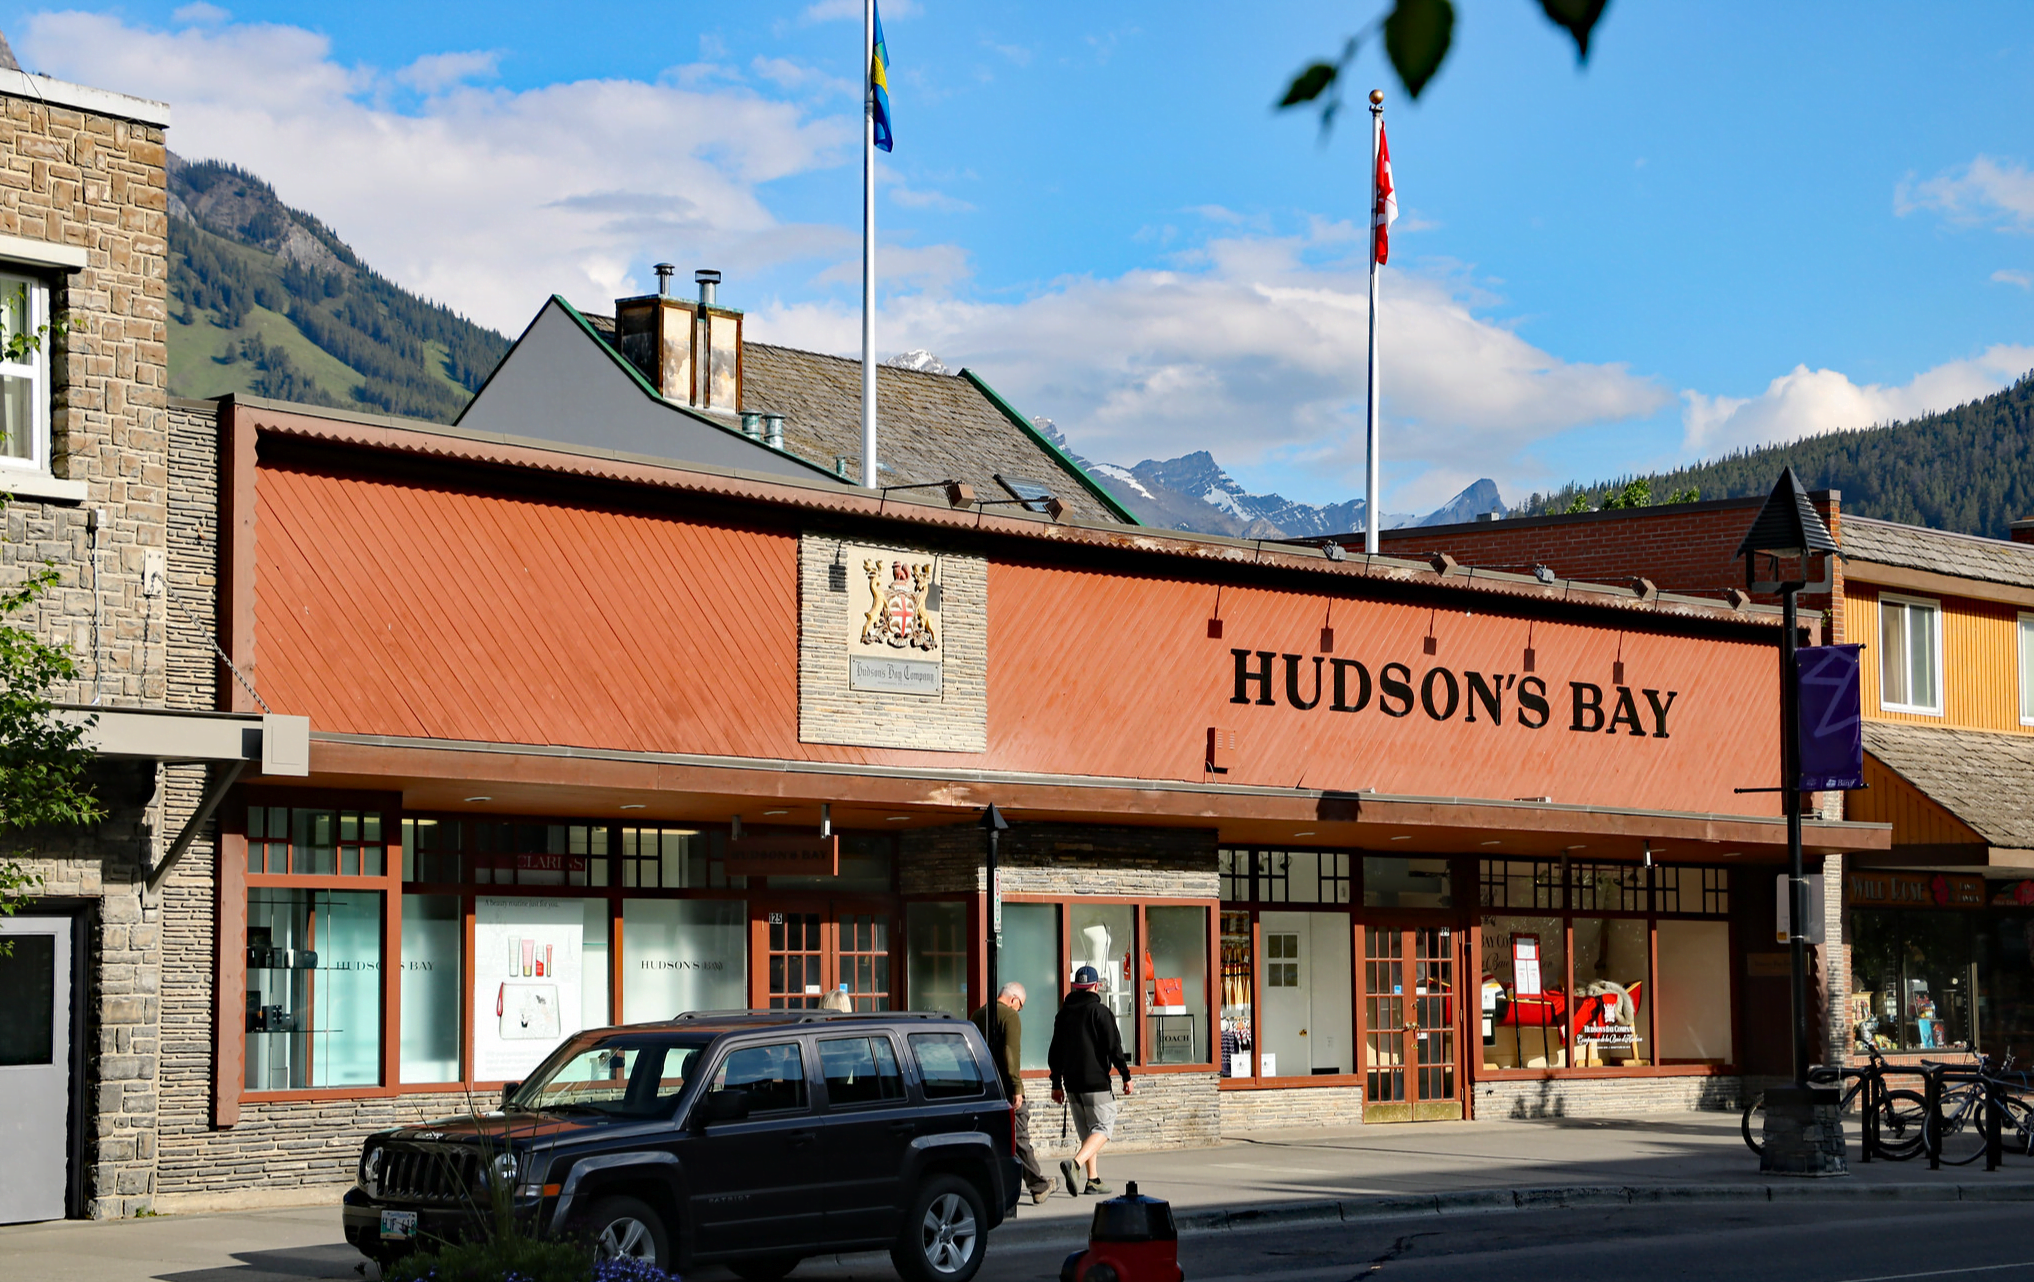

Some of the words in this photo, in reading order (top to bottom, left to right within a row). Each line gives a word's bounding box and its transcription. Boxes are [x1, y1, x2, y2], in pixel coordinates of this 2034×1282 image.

[1229, 648, 1551, 729] HUDSON'S
[1568, 681, 1678, 739] BAY
[1851, 875, 1885, 900] WILD
[1891, 877, 1925, 901] ROSE
[769, 913, 782, 923] 125
[410, 961, 435, 971] BAY
[641, 960, 700, 970] HUDSON'S
